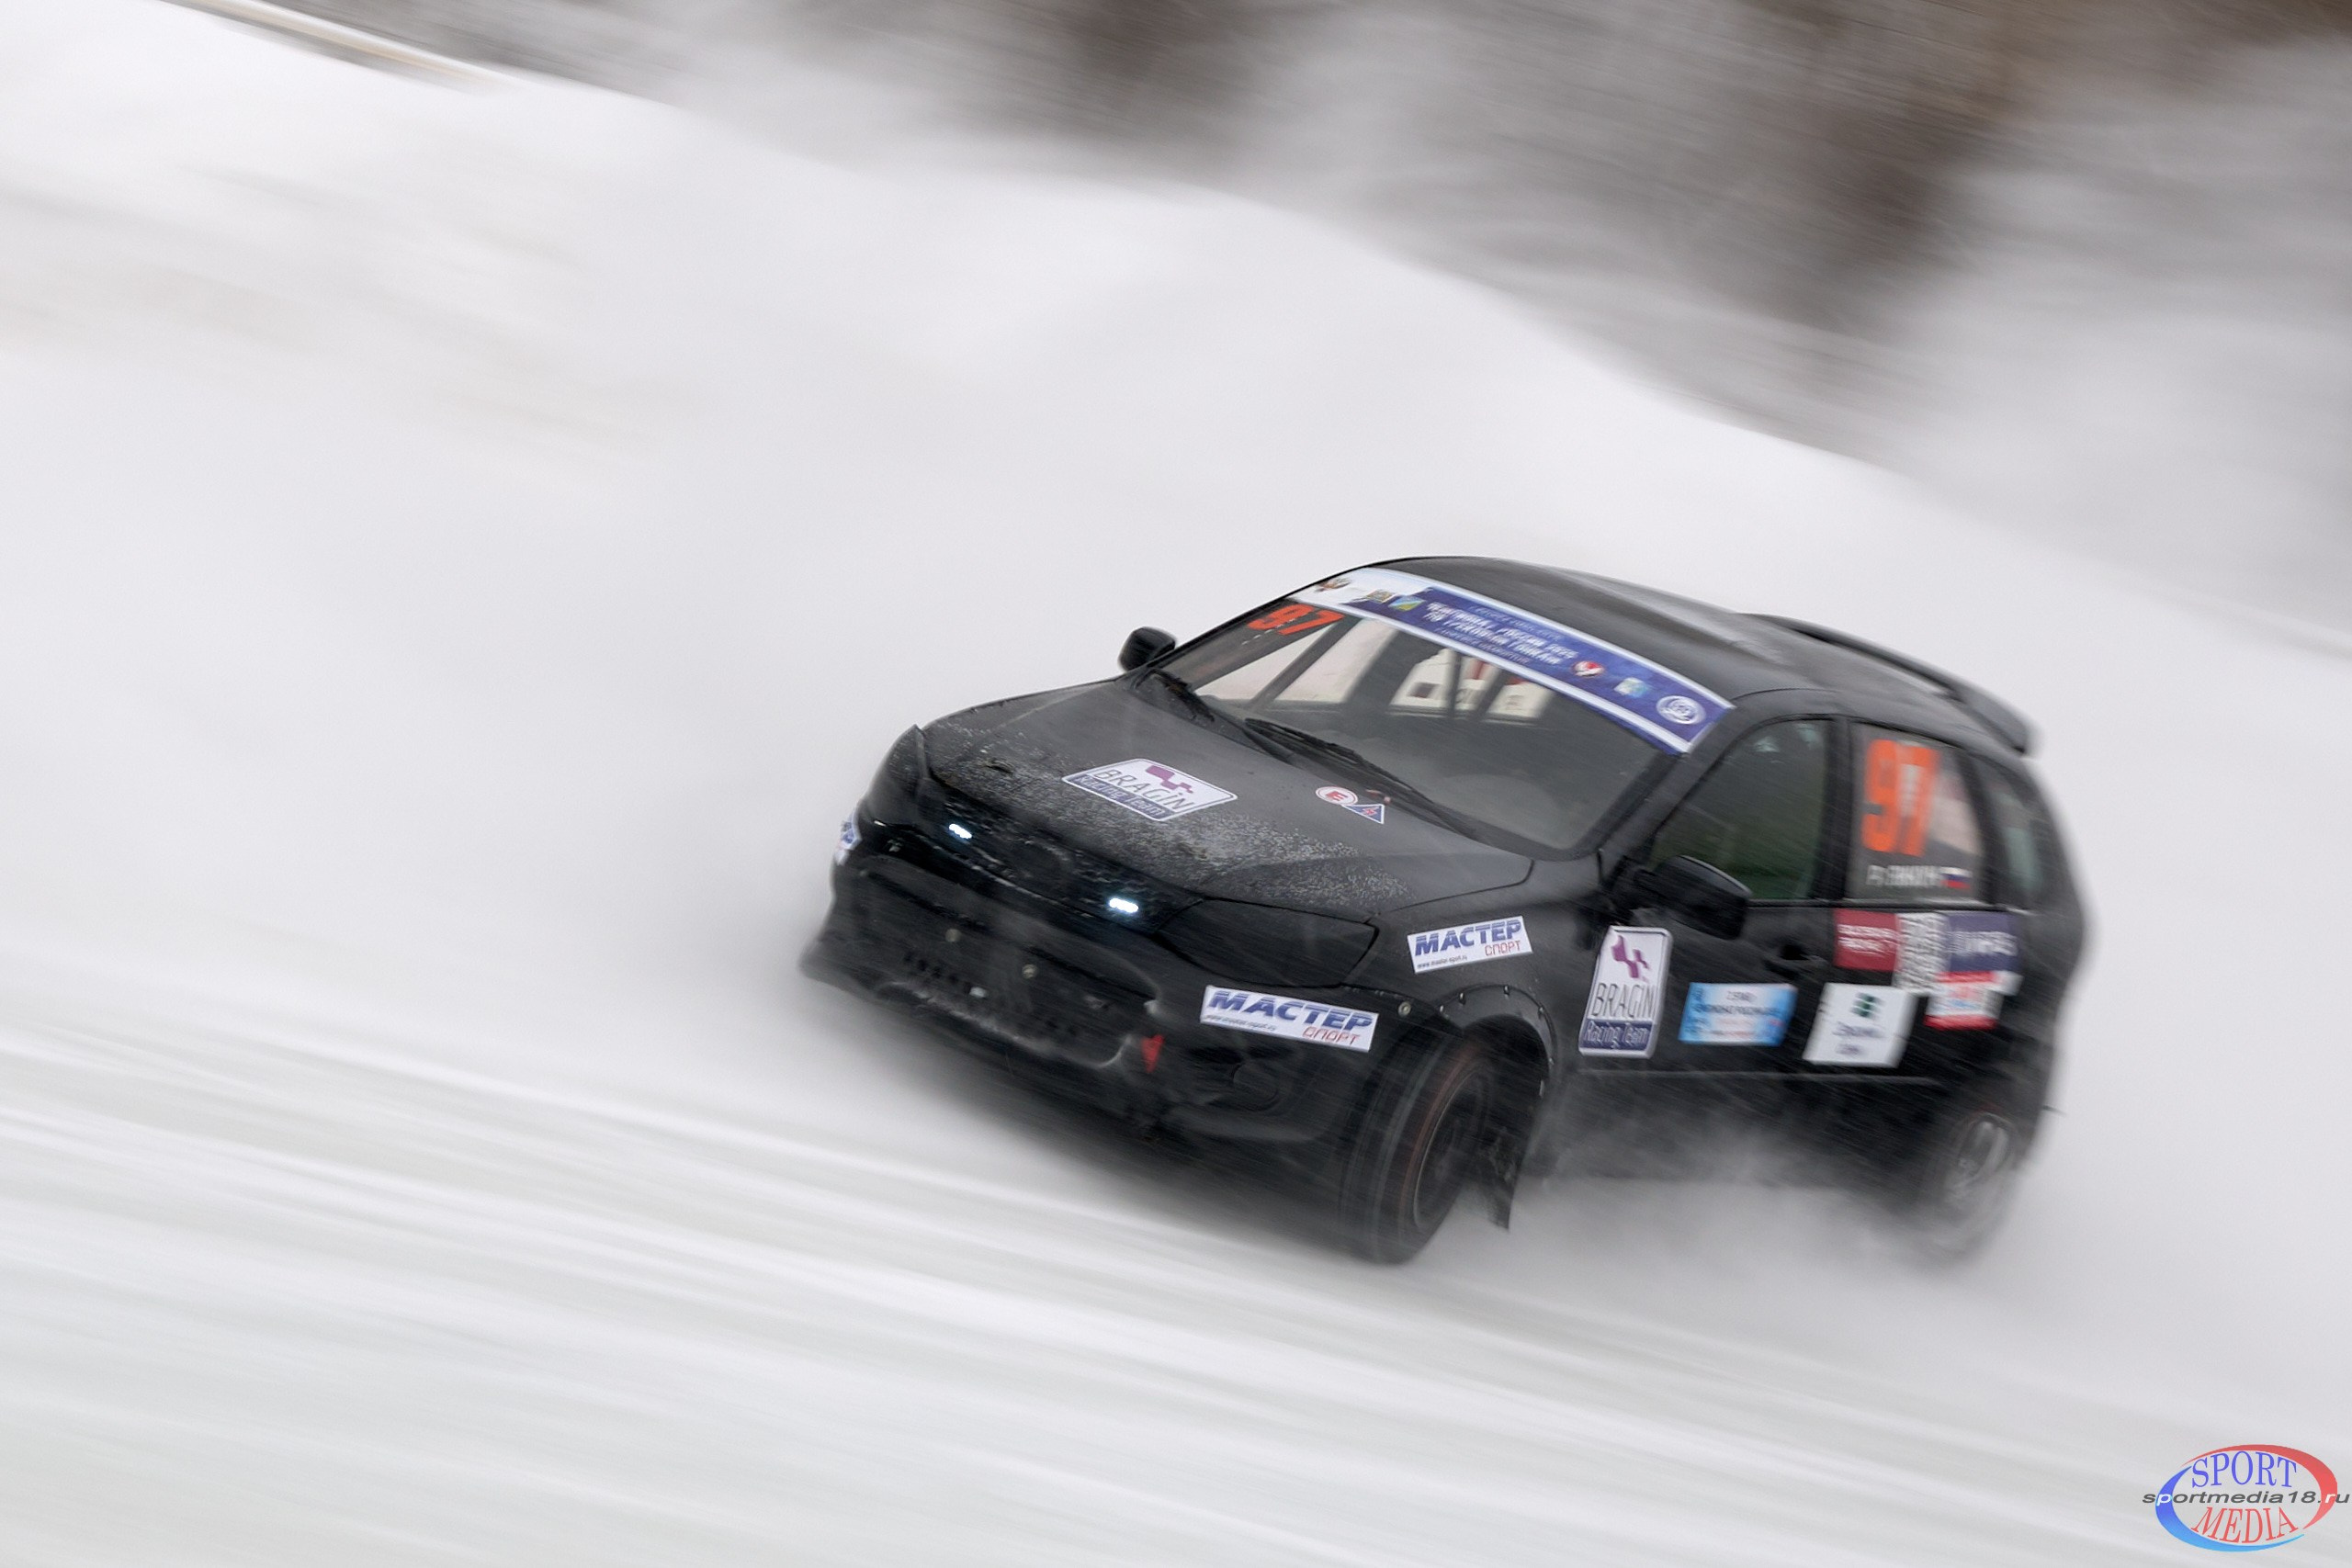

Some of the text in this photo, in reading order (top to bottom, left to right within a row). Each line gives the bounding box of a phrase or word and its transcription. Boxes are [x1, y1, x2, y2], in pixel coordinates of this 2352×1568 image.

[1247, 604, 1345, 636] 97
[1861, 739, 1939, 856] 97
[1414, 919, 1521, 956] МАСТЕР
[1484, 940, 1521, 956] СПОРТ
[1208, 990, 1373, 1031] МАСТЕР
